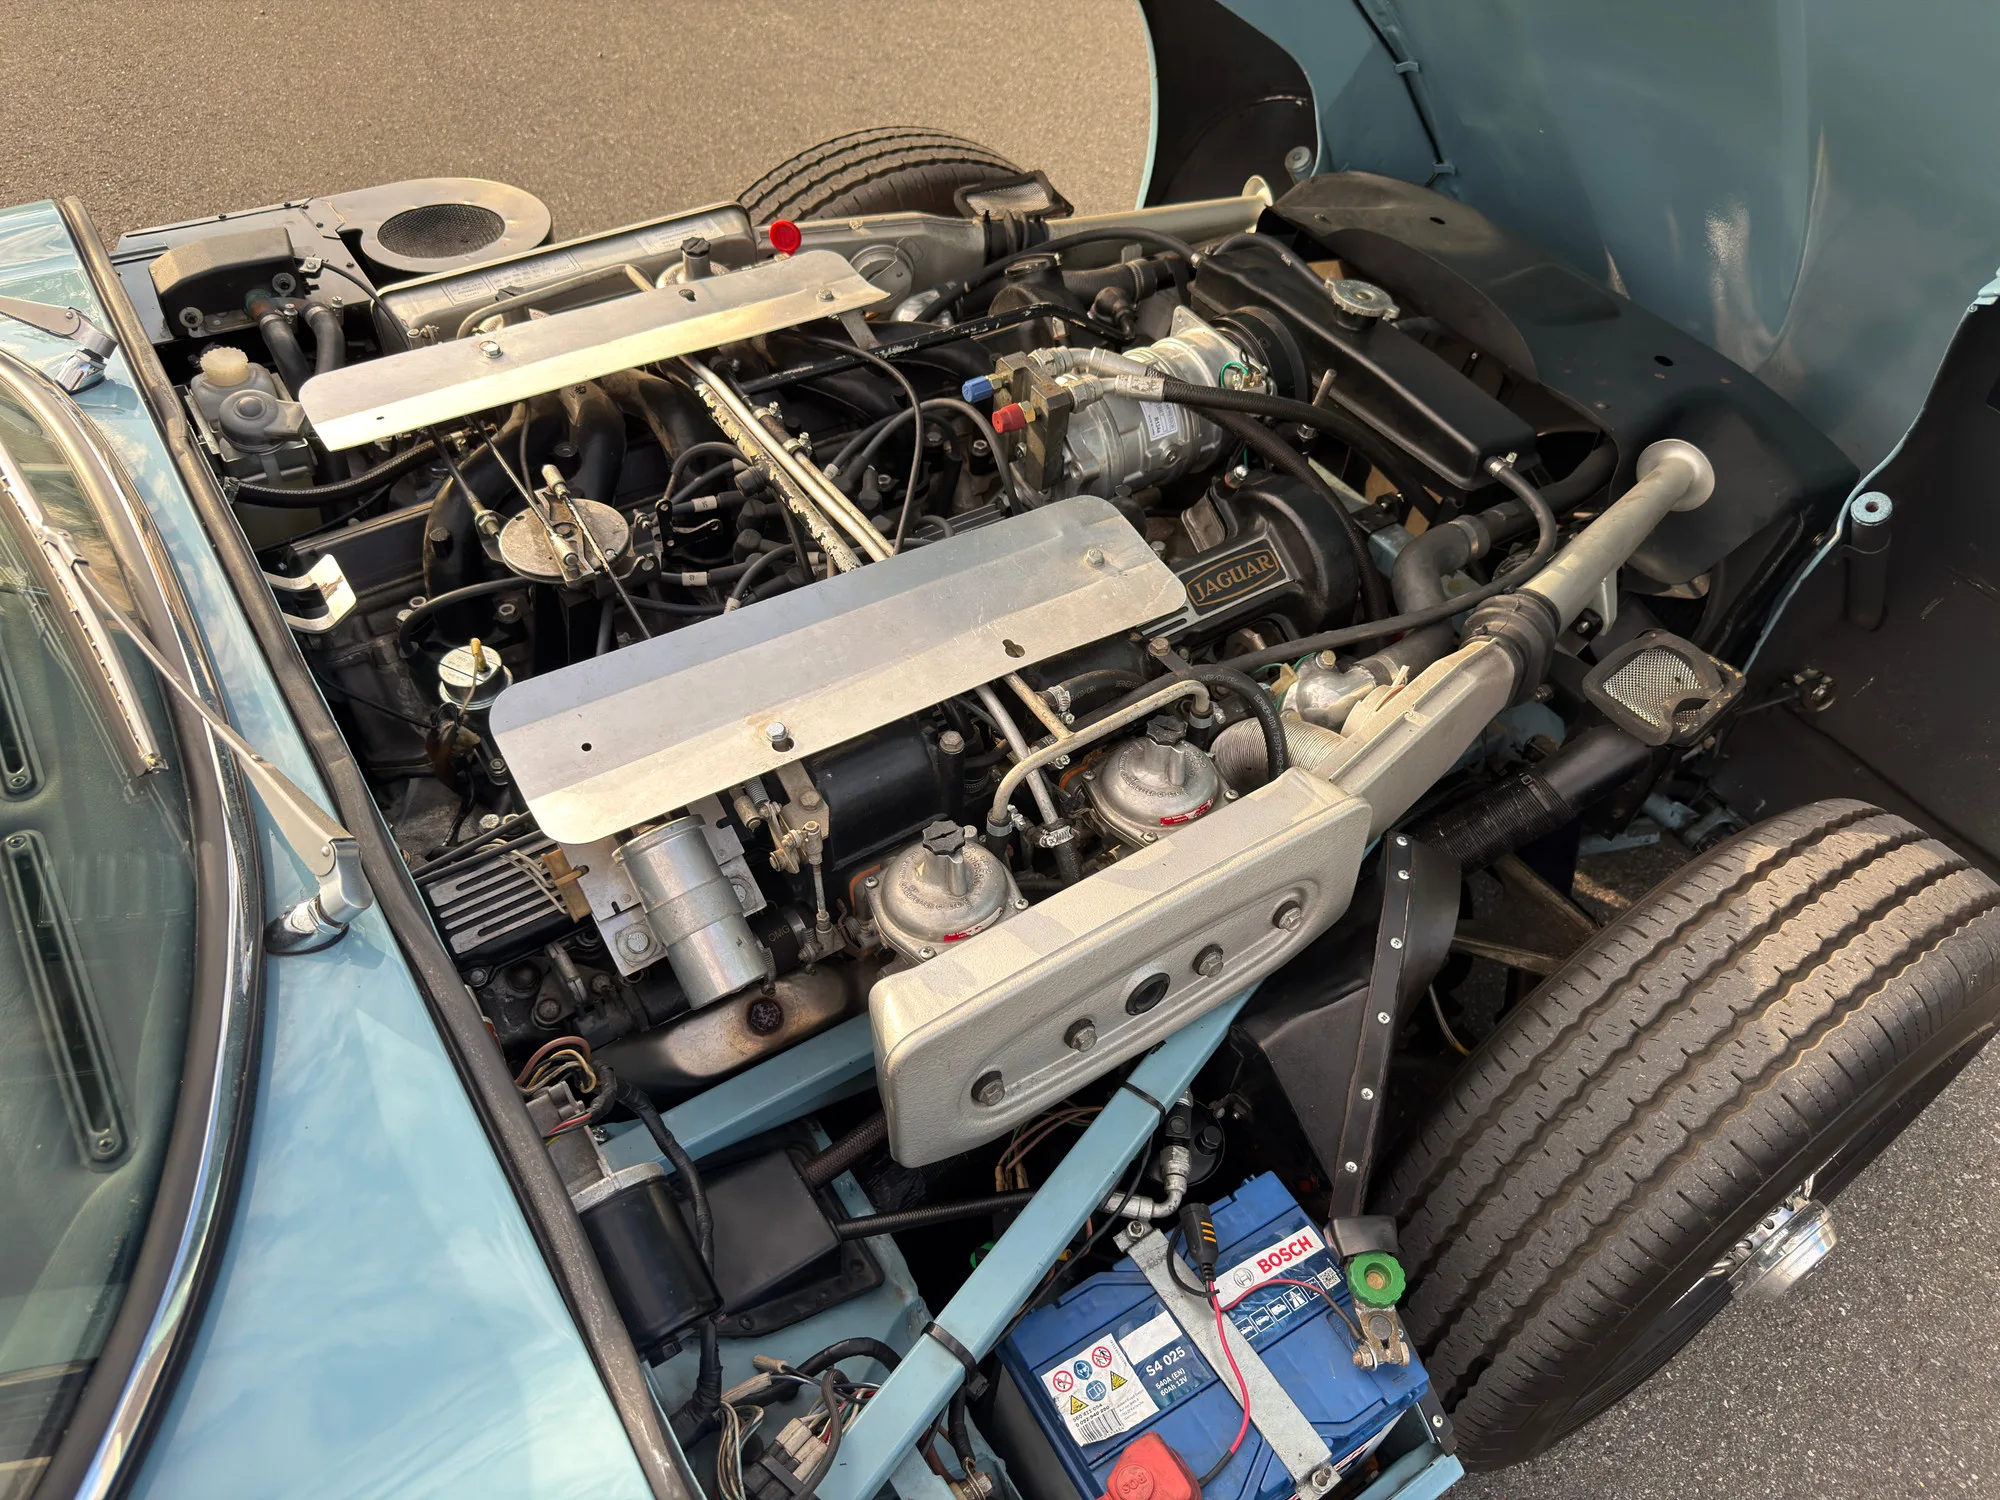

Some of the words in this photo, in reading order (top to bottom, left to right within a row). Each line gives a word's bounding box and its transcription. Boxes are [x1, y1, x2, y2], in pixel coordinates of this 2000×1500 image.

[1194, 554, 1275, 602] JAGUAR
[768, 925, 790, 941] OMG
[1256, 1235, 1314, 1274] BOSCH
[1145, 1360, 1163, 1377] S4
[1162, 1346, 1186, 1366] 025
[1155, 1376, 1172, 1390] 540A
[1171, 1367, 1186, 1380] (EN)
[1160, 1383, 1177, 1396] 60Ah
[1176, 1375, 1188, 1387] 12V
